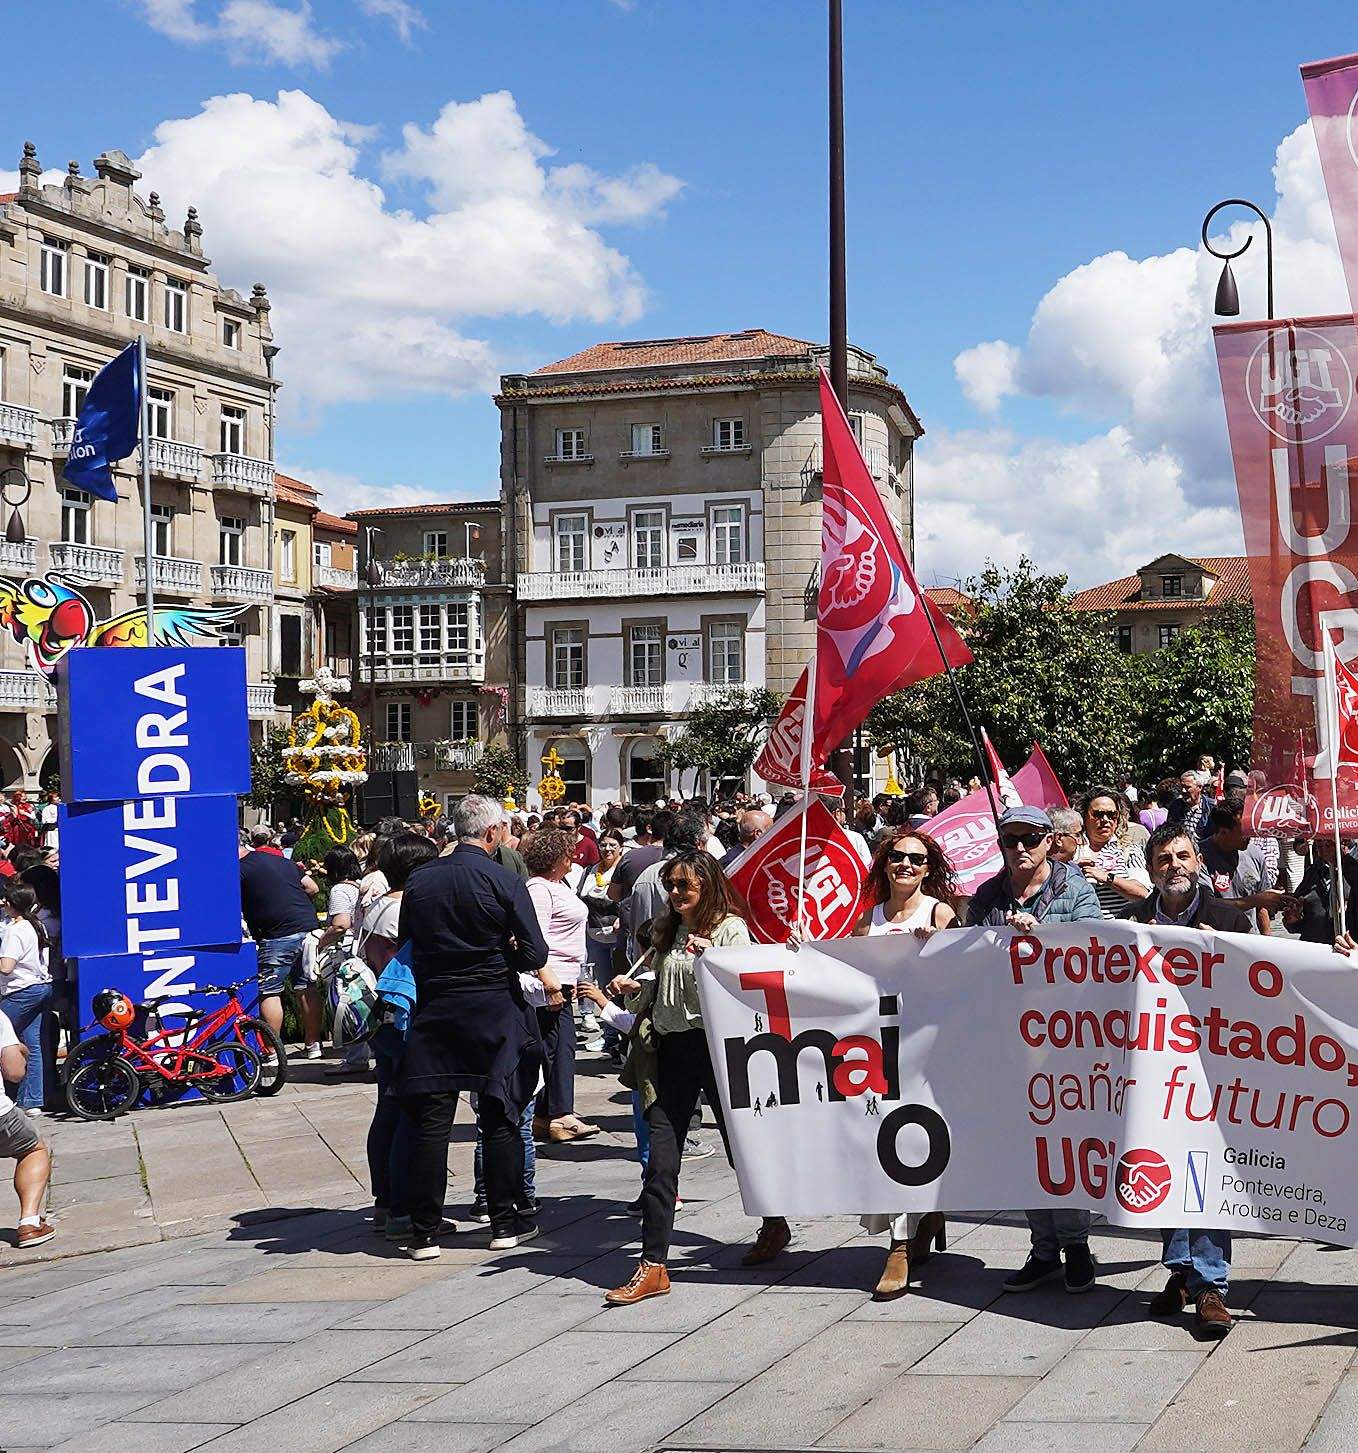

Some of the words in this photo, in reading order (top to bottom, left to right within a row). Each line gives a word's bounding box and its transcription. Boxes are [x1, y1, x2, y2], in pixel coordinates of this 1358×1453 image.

[1261, 349, 1333, 396] UGT
[123, 663, 198, 1068] ONTEVEDRA
[783, 844, 853, 921] UGT
[1009, 934, 1225, 988] Protexer
[1248, 959, 1284, 997] o
[1162, 1065, 1351, 1138] futuro
[1223, 1147, 1286, 1170] Galicia
[1218, 1199, 1282, 1221] Arousa
[1288, 1209, 1299, 1223] e
[1304, 1208, 1347, 1232] Deza
[1221, 1175, 1327, 1206] Pontevedra,
